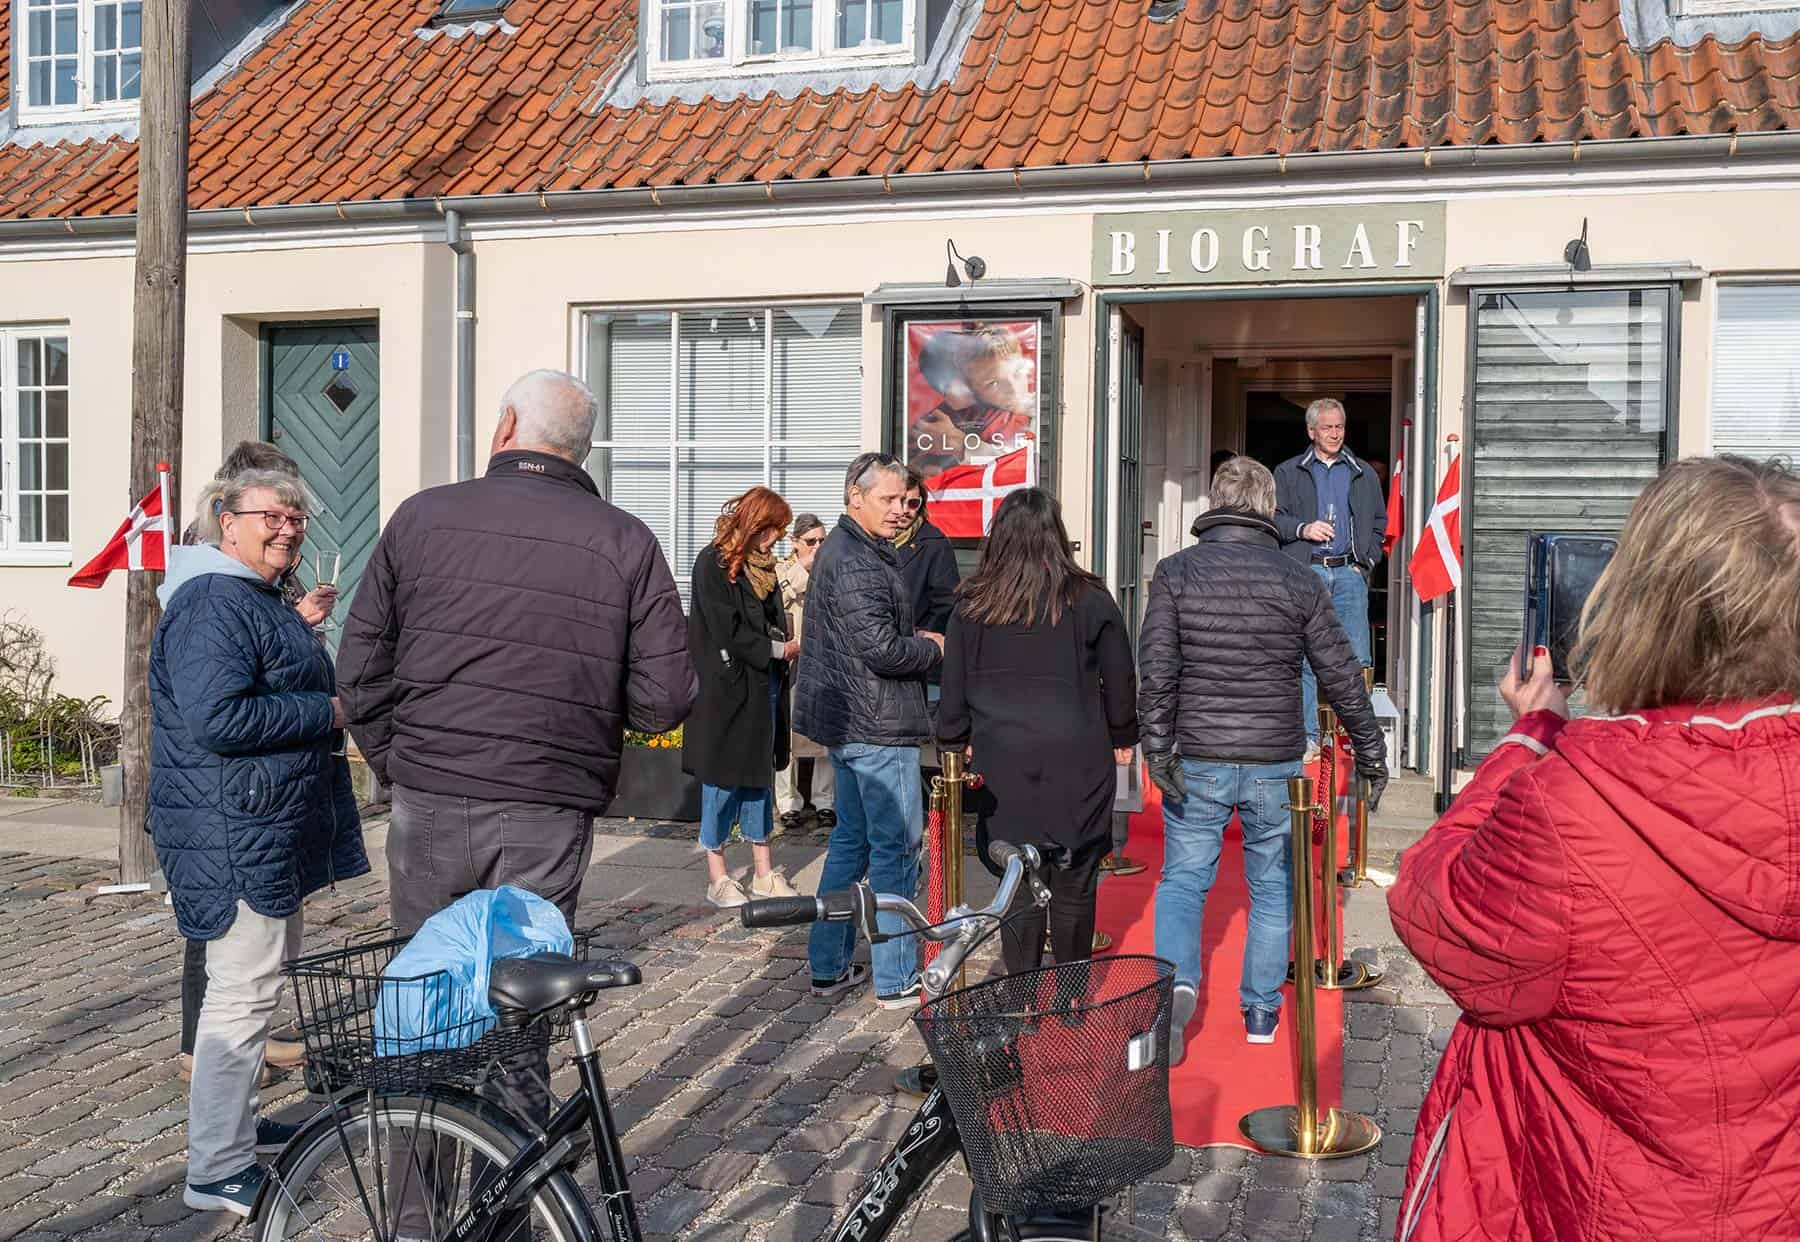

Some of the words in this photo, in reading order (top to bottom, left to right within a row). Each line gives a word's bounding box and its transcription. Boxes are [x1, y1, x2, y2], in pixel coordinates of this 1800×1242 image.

[1109, 220, 1425, 276] BIOGRAF
[917, 433, 1027, 450] CLOSE
[482, 1190, 494, 1208] 52
